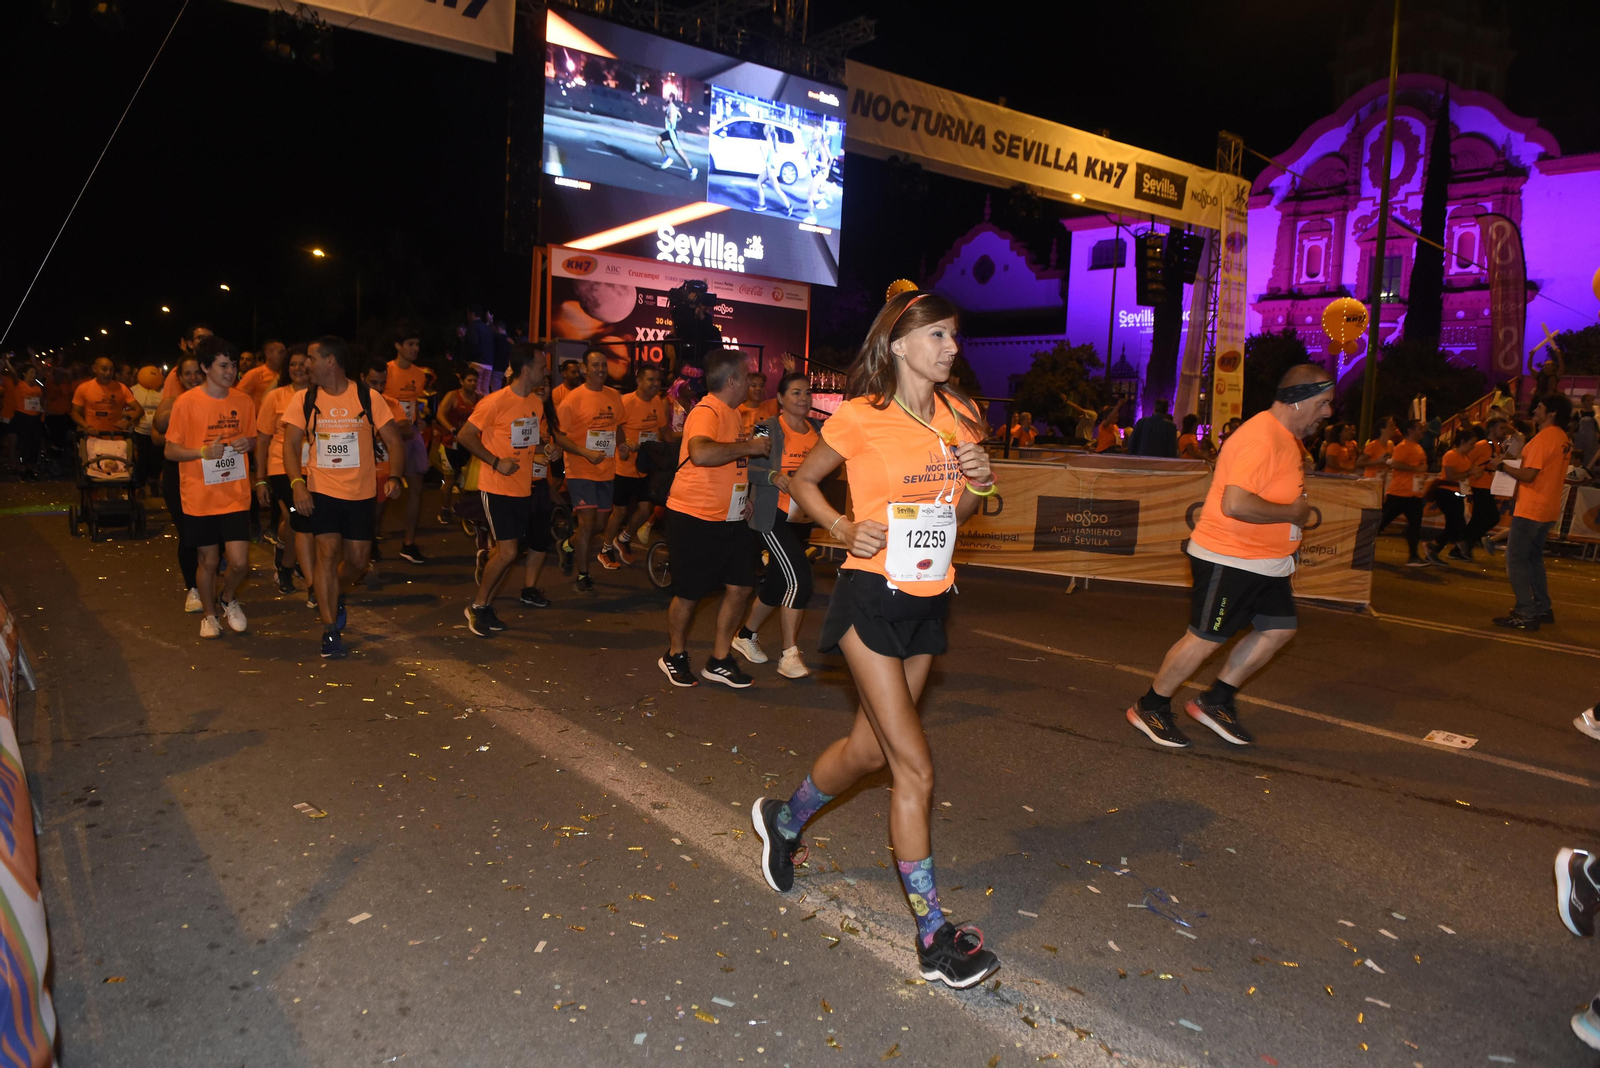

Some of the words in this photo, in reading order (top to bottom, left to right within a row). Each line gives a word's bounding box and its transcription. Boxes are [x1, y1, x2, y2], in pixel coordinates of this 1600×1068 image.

[851, 88, 986, 150] NOCTURNA
[991, 129, 1079, 175] SEVILLA
[605, 265, 621, 273] ABC
[628, 269, 660, 280] Cruzcampo
[655, 317, 664, 325] 30
[327, 444, 348, 454] 5998
[595, 440, 610, 448] 4607
[215, 457, 235, 469] 4609
[903, 473, 944, 484] SEVILLA
[968, 530, 1020, 542] Municipal
[1050, 525, 1122, 537] AYUNTAMIENTO
[906, 529, 946, 549] 12259
[1060, 535, 1072, 544] DE
[1300, 544, 1338, 555] nicipal
[1213, 617, 1222, 631] FILA
